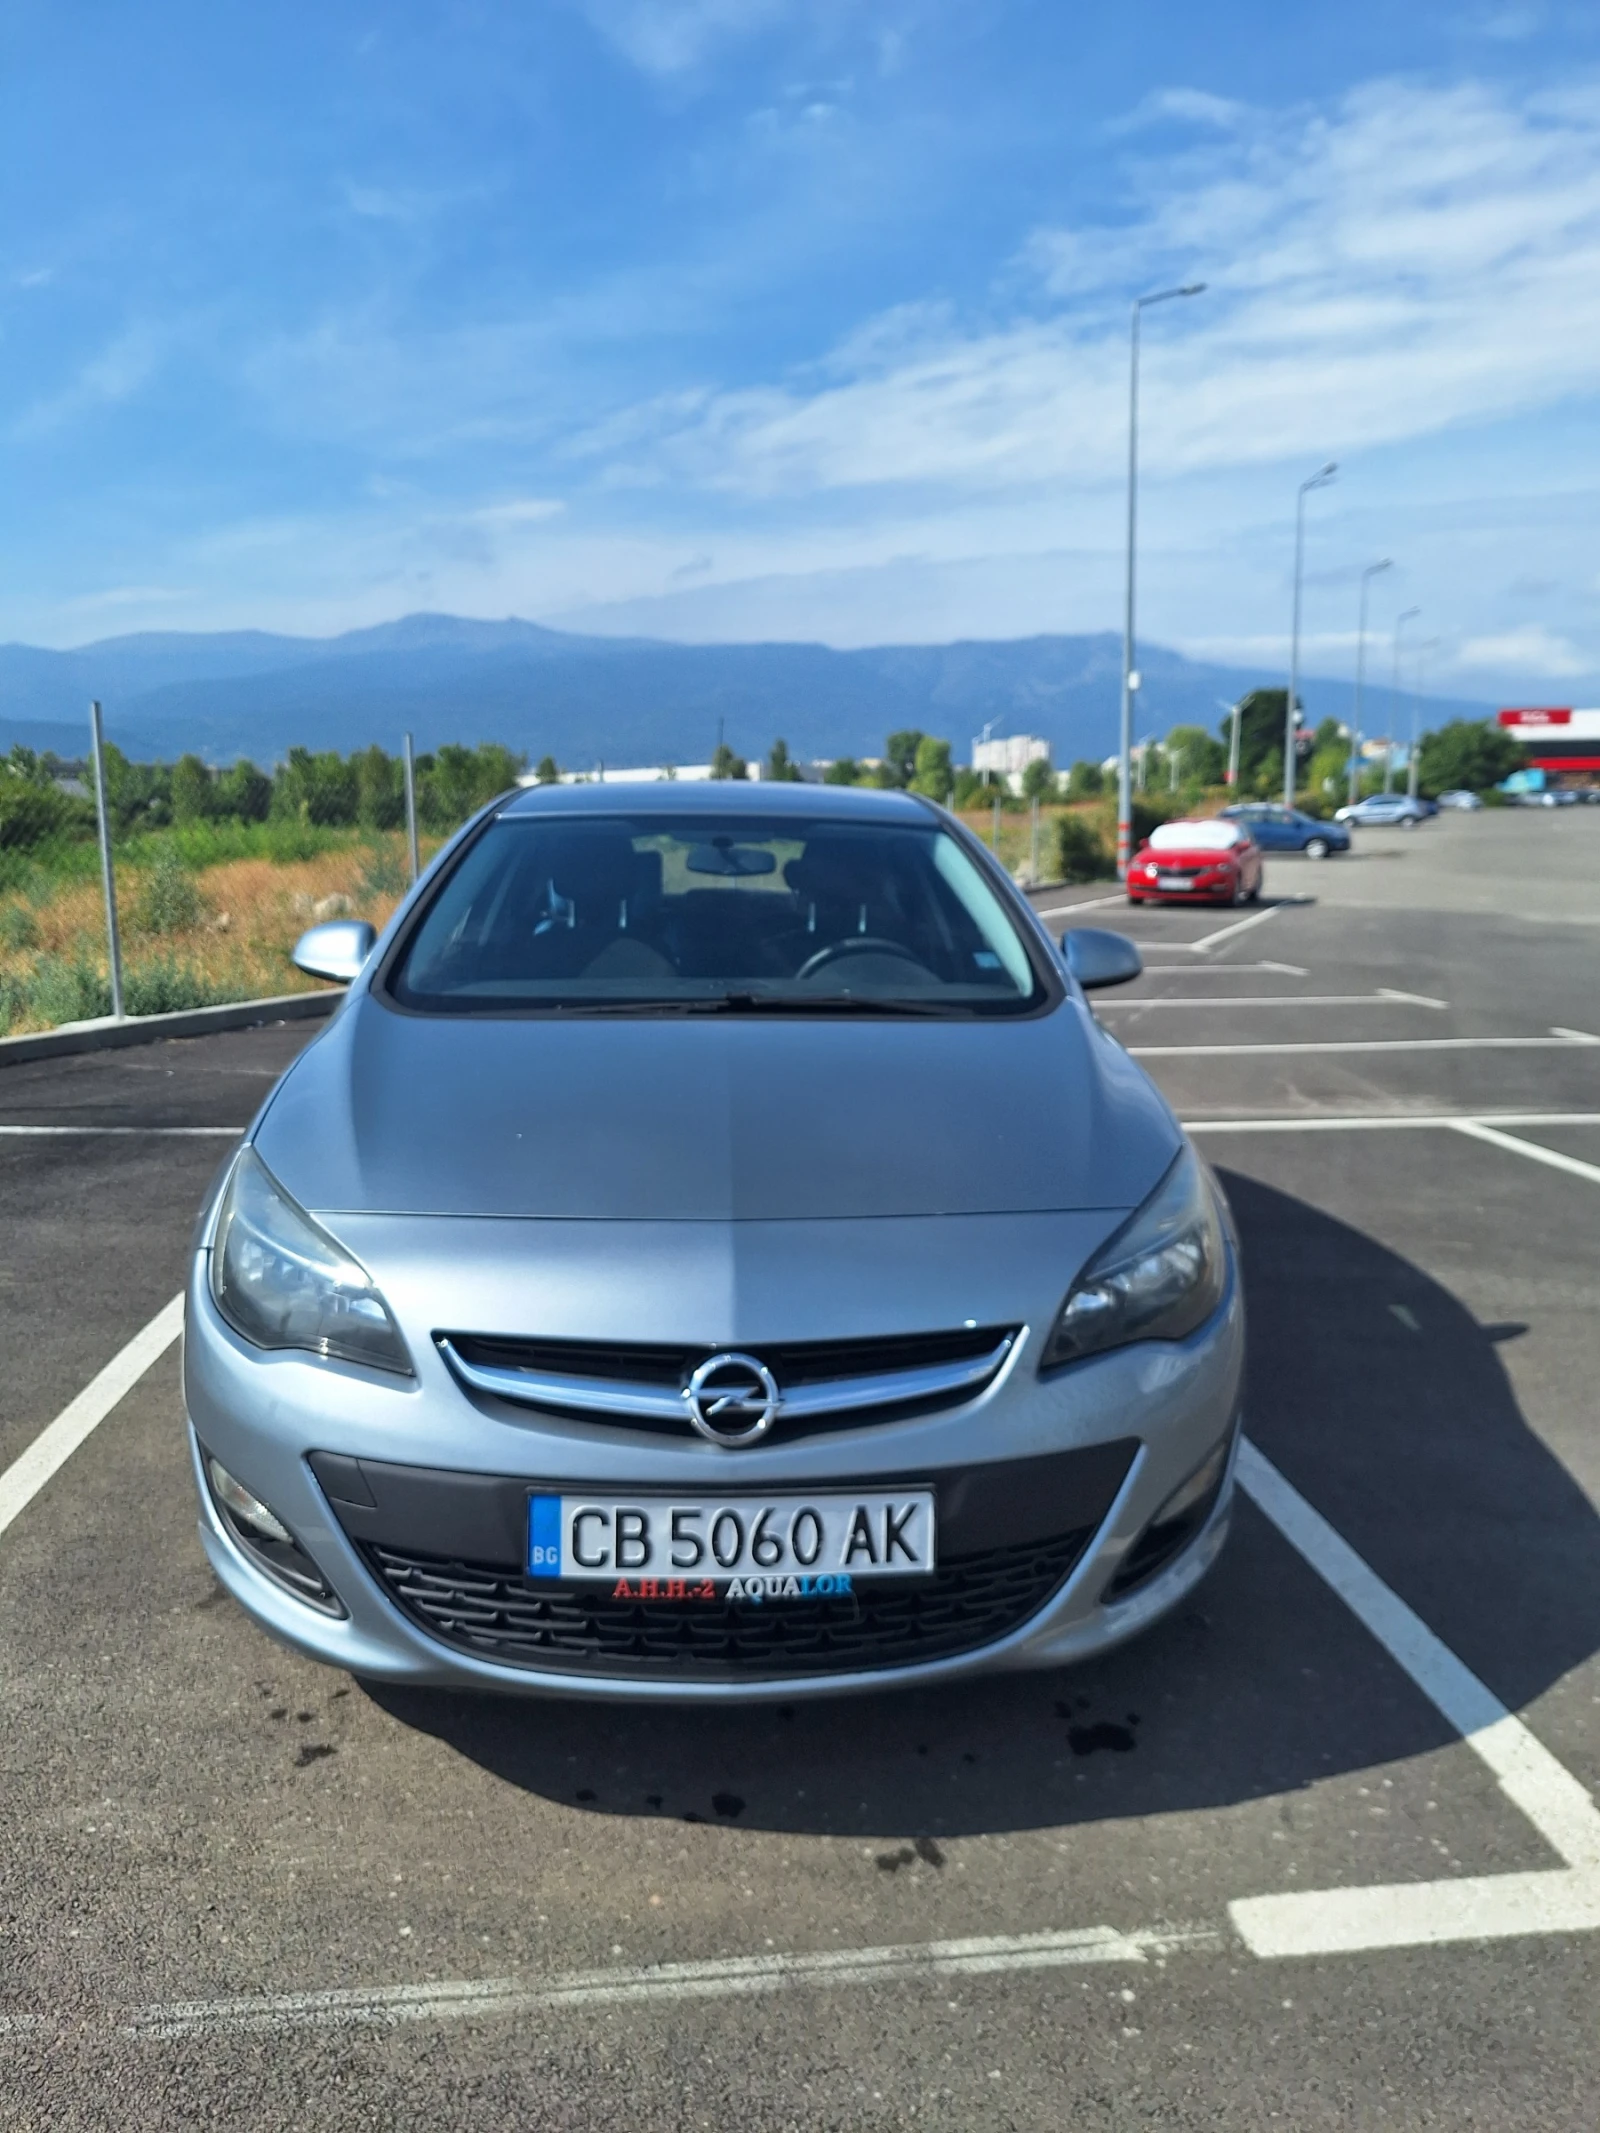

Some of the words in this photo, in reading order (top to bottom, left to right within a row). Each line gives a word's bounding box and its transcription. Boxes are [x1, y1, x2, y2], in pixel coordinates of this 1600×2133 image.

[570, 1504, 653, 1568] CB
[669, 1505, 825, 1568] 5060
[840, 1502, 920, 1566] AK
[532, 1545, 559, 1566] BG
[725, 1573, 853, 1604] AQUALOR
